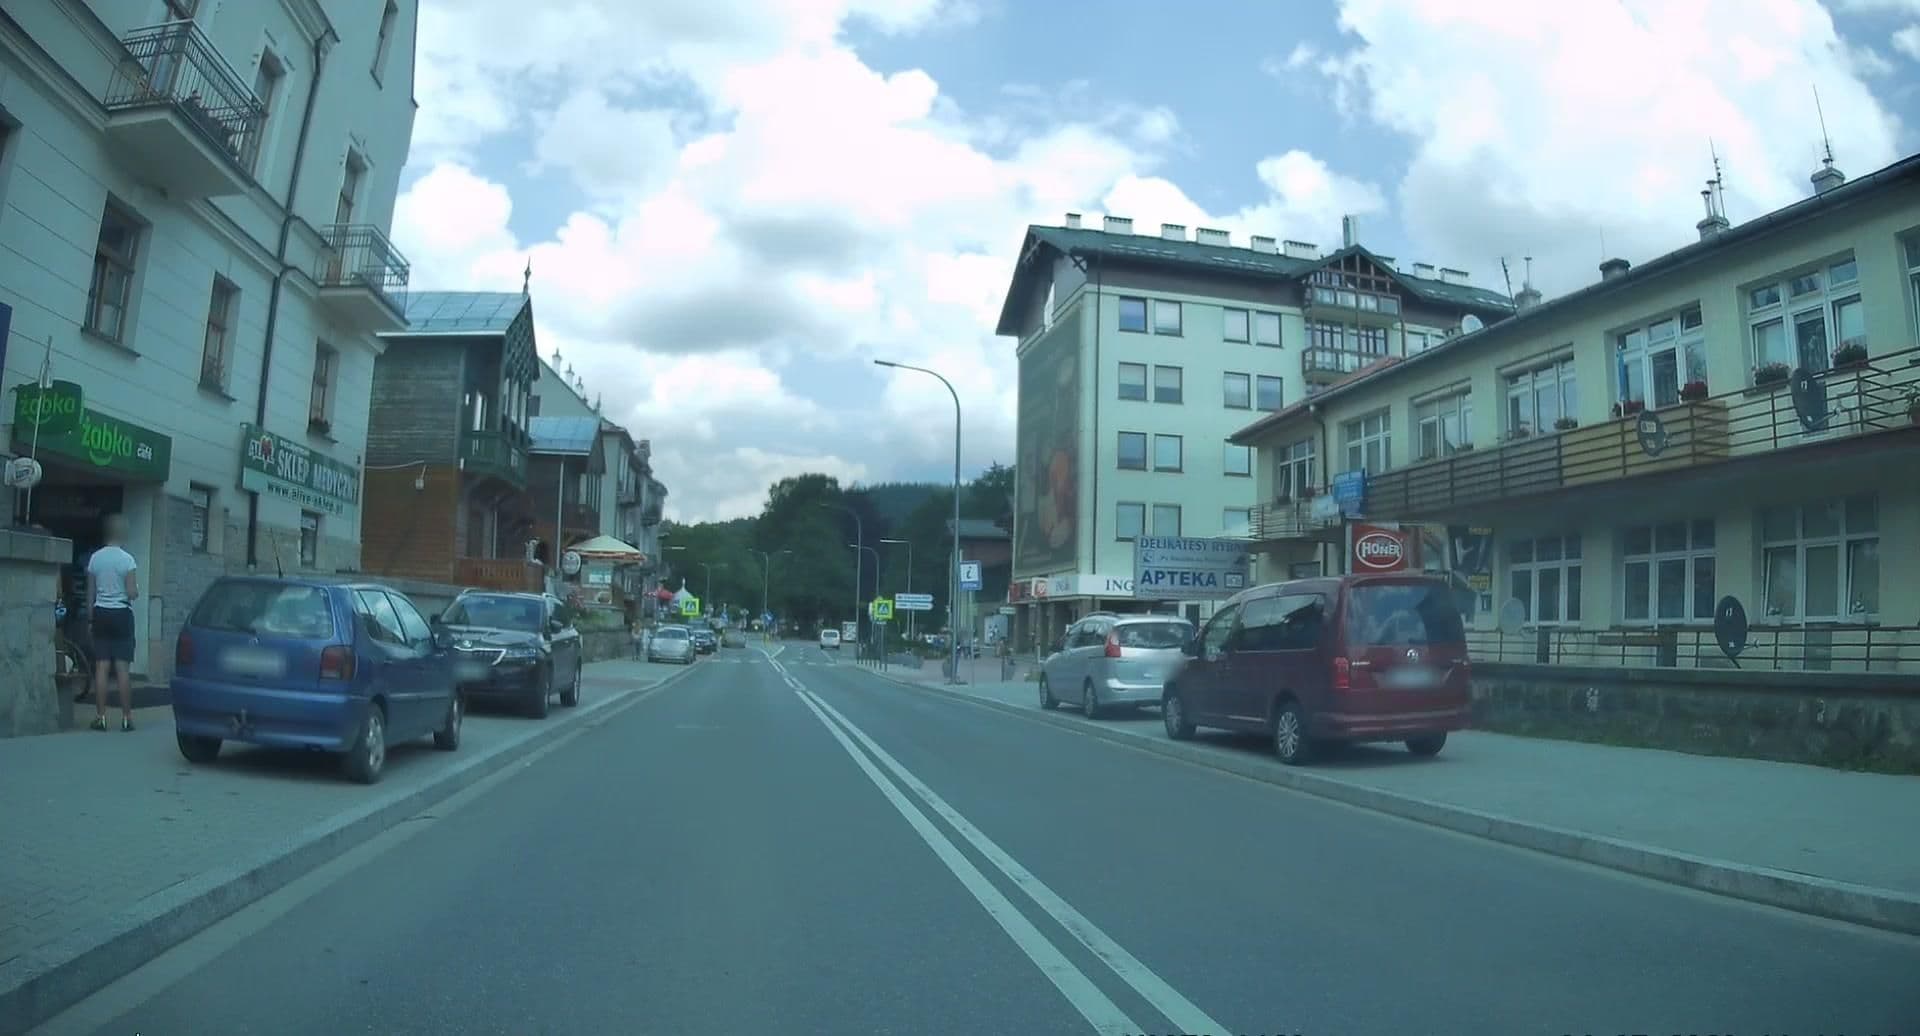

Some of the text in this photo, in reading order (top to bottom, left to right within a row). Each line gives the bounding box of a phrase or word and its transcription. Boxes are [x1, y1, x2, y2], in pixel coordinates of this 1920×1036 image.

[81, 415, 133, 457] żabka
[278, 449, 310, 484] SKLEP
[1140, 537, 1208, 552] DELIKATESY
[1105, 578, 1134, 592] ING
[1140, 570, 1217, 587] APTEKA
